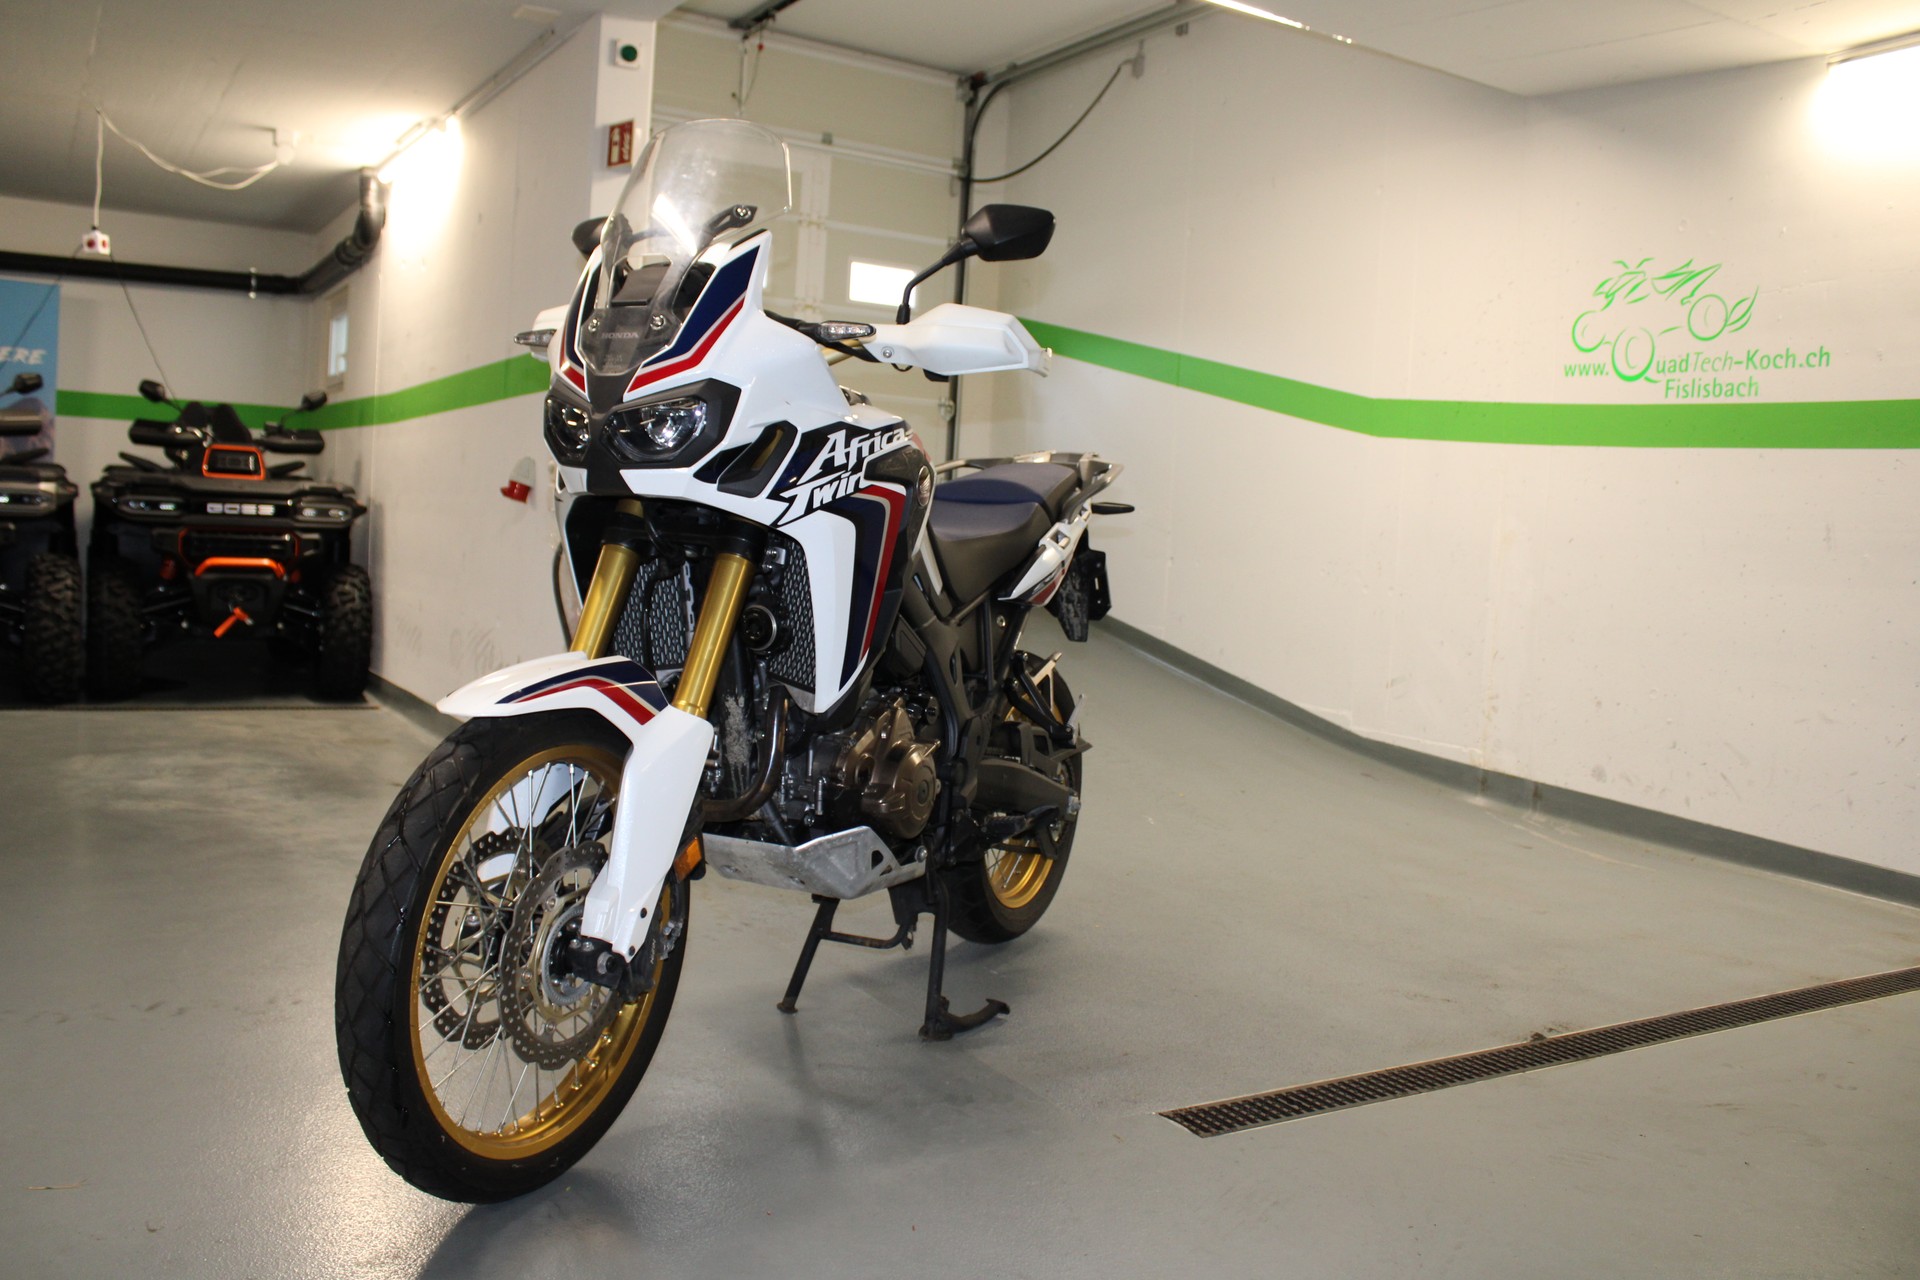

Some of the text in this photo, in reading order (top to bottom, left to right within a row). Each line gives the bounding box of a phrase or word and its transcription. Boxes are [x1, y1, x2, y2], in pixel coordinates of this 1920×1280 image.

[601, 331, 639, 339] HONDA
[1564, 327, 1831, 382] www.QuadTech-Koch.ch
[1664, 376, 1760, 399] Fislisbach
[796, 428, 907, 486] Africa
[777, 470, 870, 526] Twin
